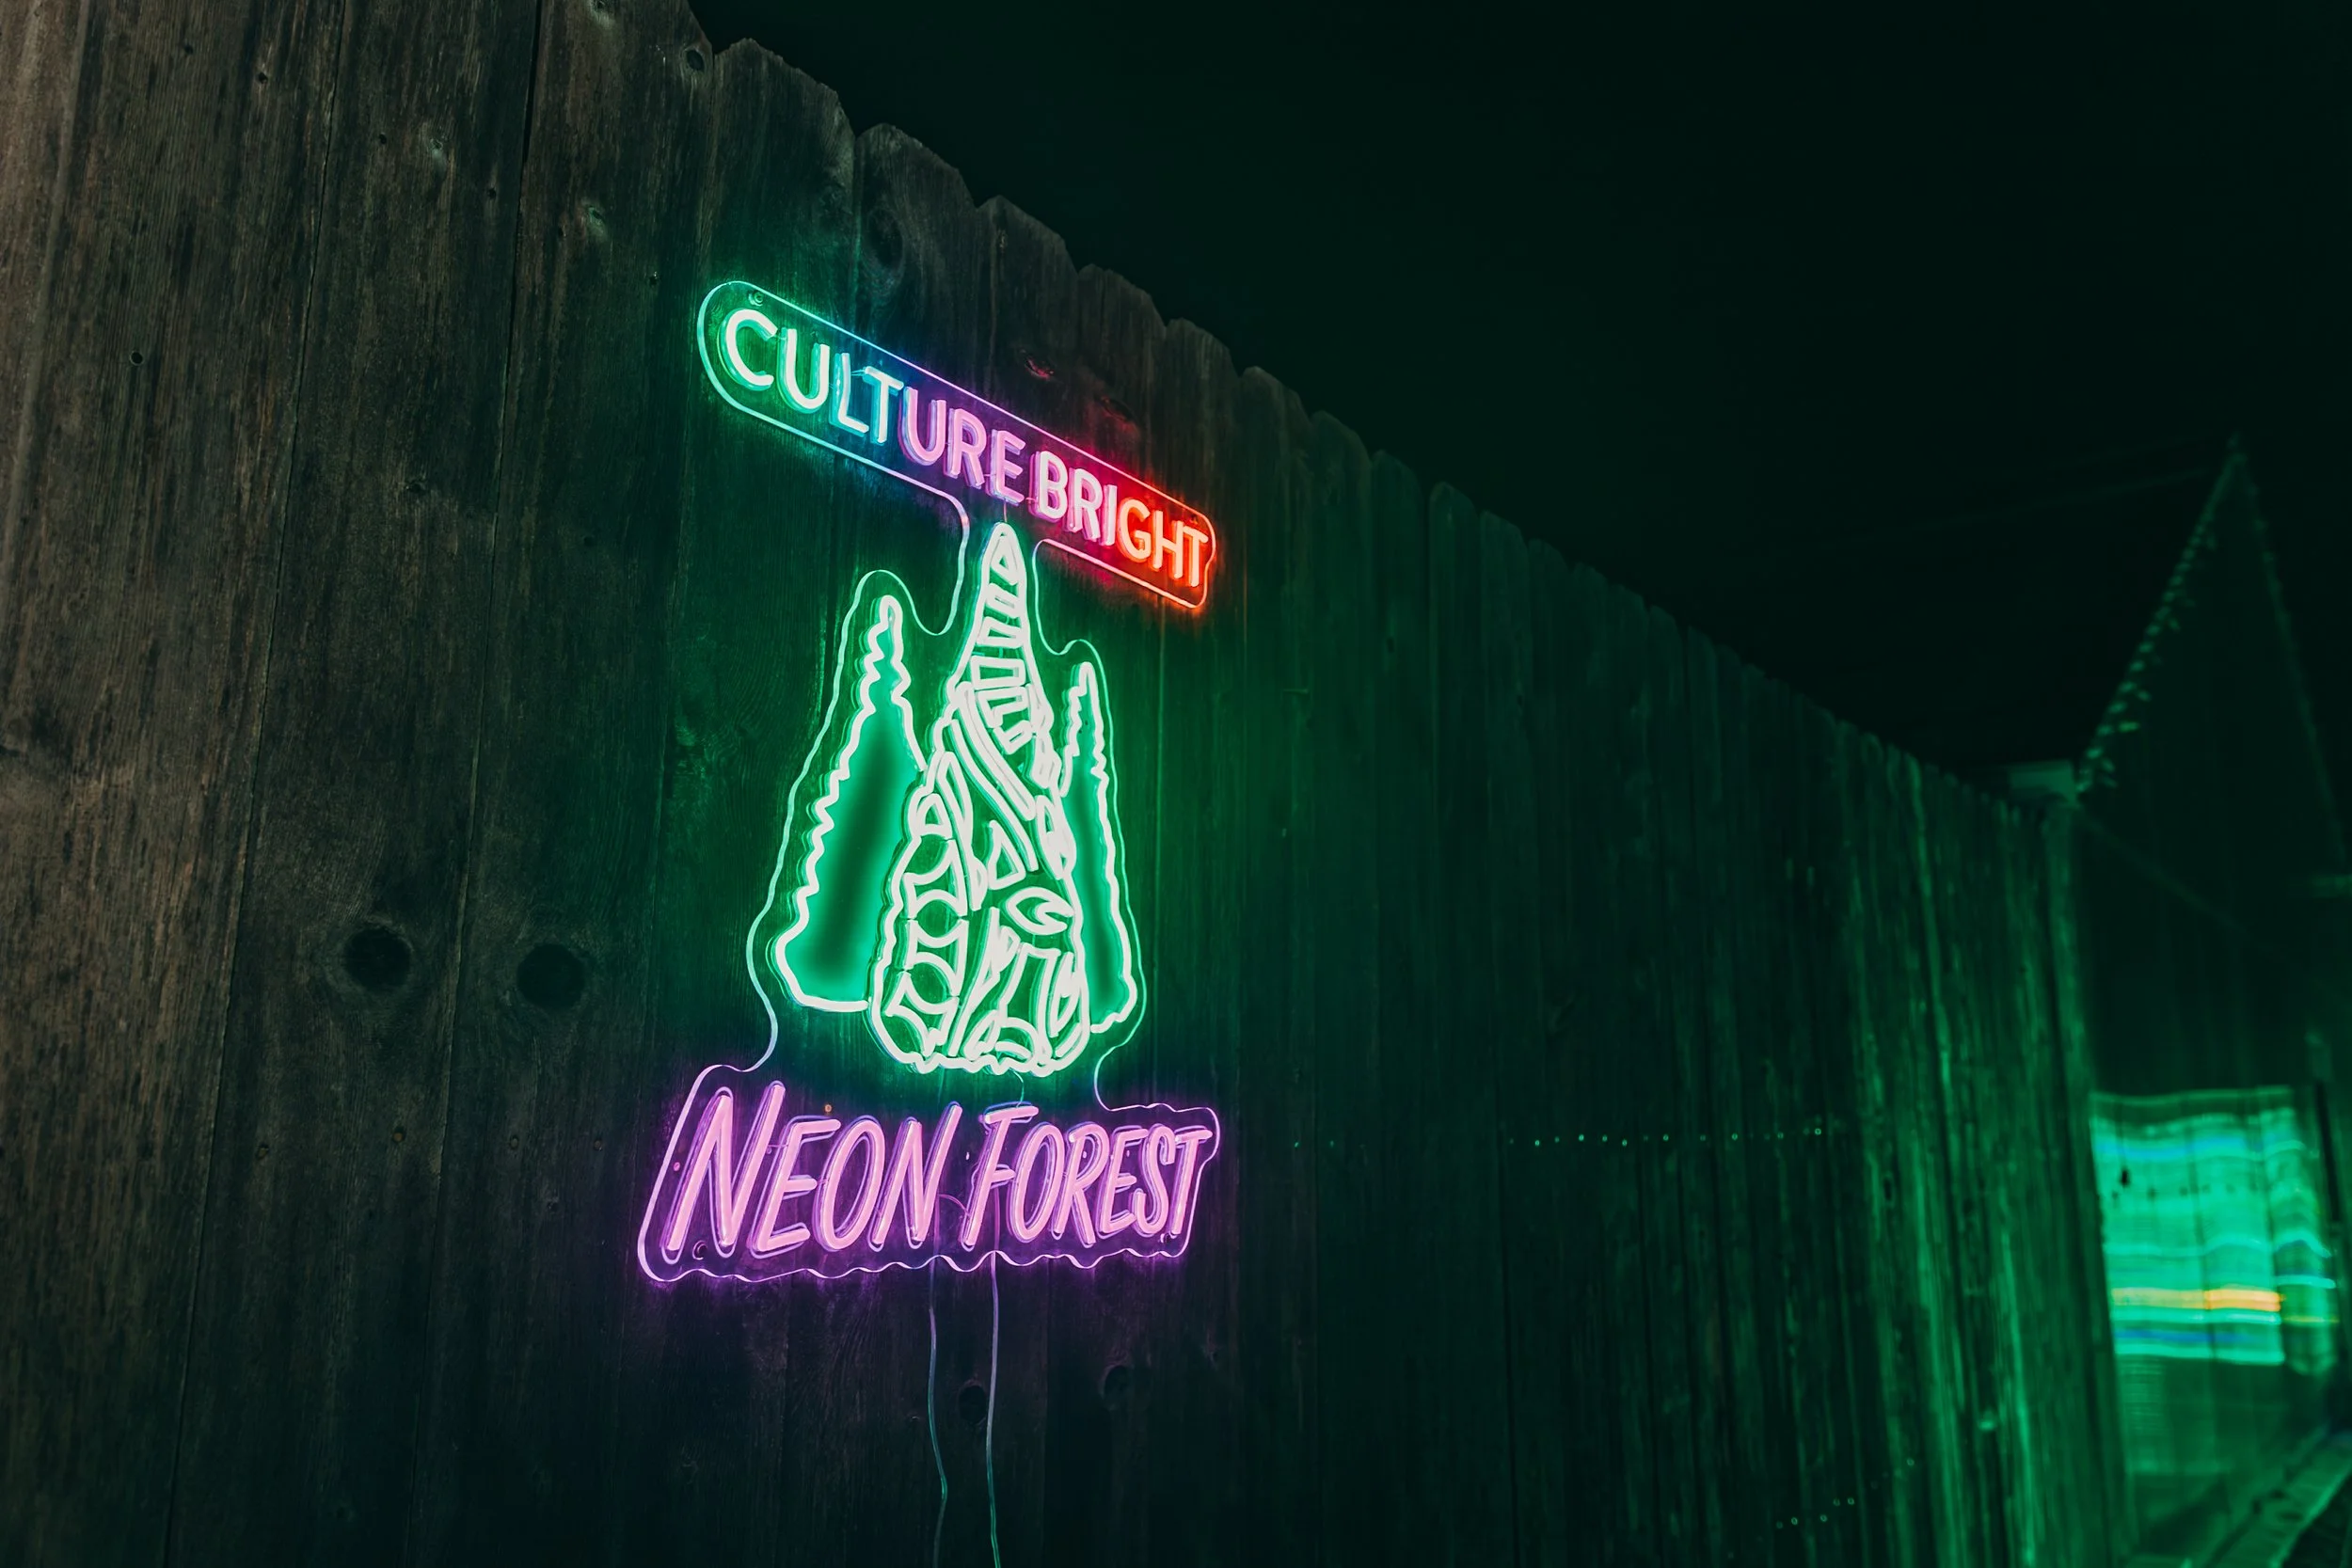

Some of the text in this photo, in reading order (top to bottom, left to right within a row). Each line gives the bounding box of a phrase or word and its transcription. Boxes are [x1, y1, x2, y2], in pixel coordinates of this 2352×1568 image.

[720, 309, 1210, 588] CULTURE BRIGHT
[661, 1082, 1213, 1262] NEON FOREST
